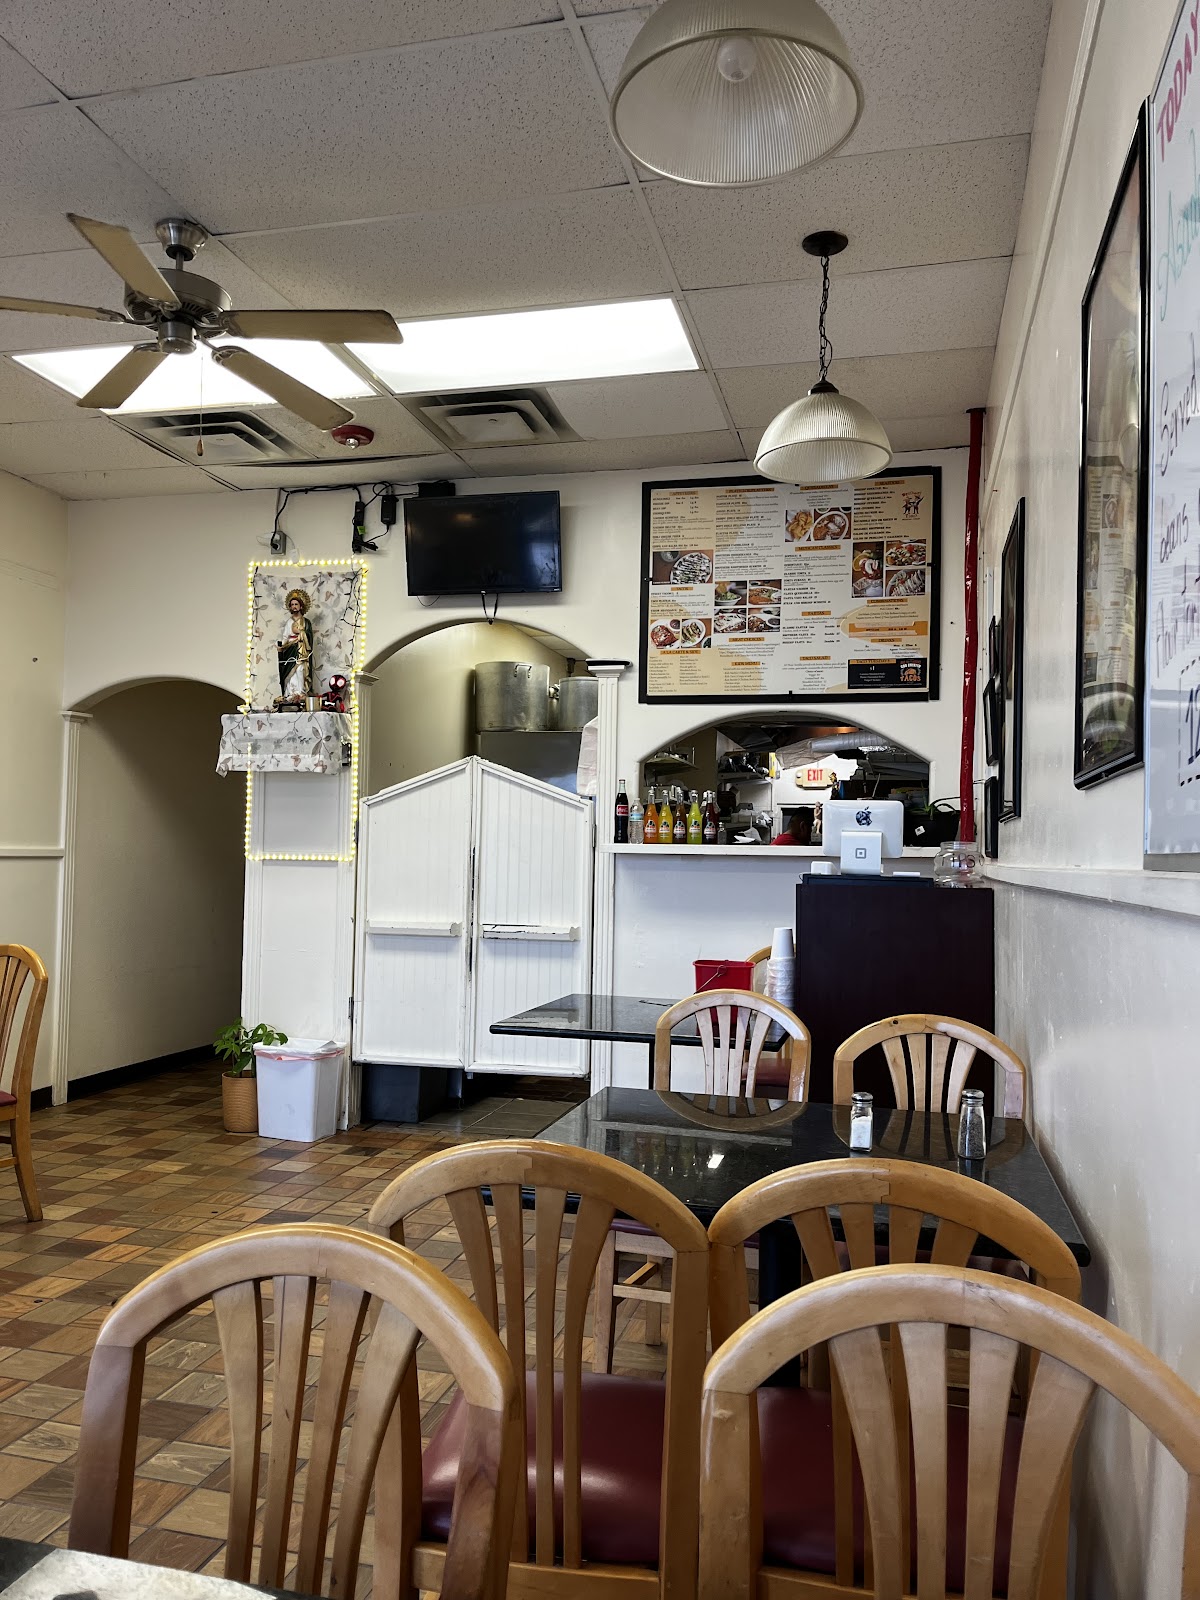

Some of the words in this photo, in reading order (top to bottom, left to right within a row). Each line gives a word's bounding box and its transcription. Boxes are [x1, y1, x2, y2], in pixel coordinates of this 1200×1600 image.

[1160, 332, 1198, 476] Served
[1160, 497, 1188, 563] beans
[808, 769, 823, 782] EXIT
